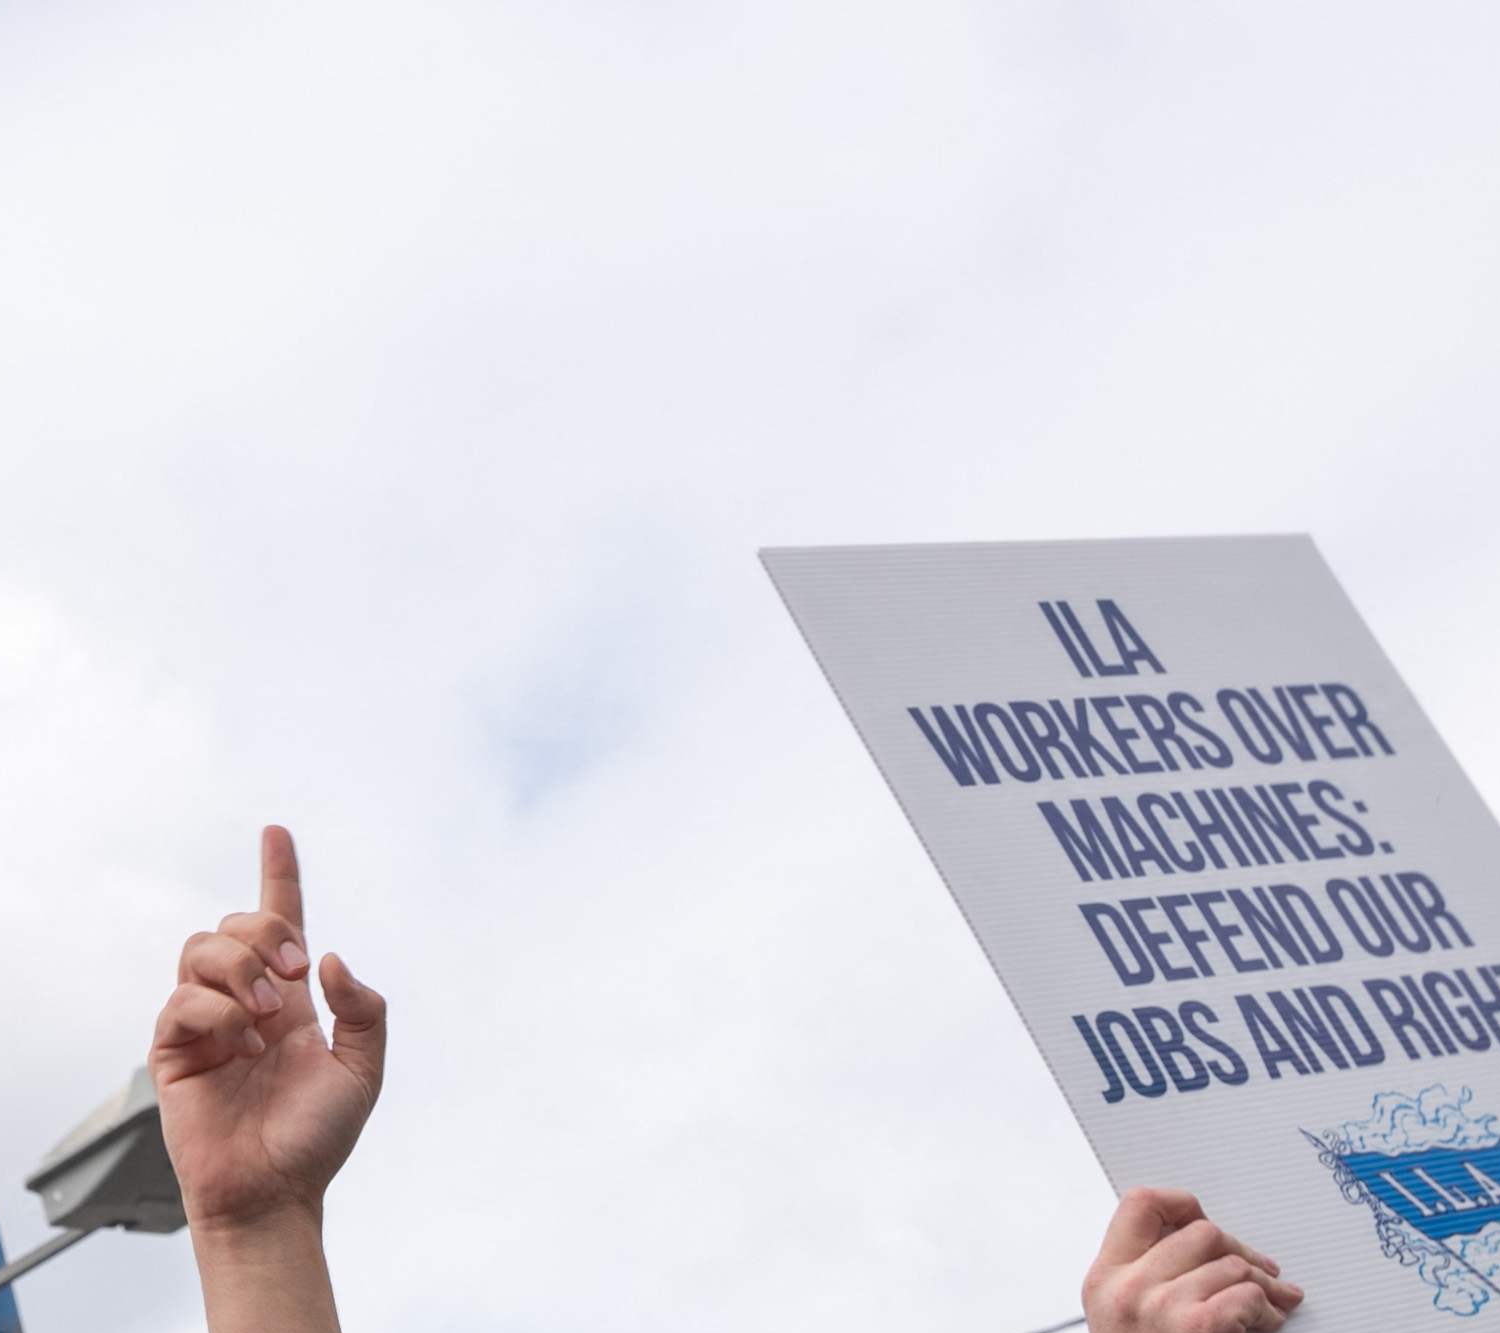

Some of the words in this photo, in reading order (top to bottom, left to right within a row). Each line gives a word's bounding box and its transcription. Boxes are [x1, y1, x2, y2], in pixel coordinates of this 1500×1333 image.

[1038, 599, 1166, 677] ILA
[908, 688, 1234, 787] WORKERS
[1214, 681, 1396, 764] OVER
[1037, 778, 1394, 882] MACHINES:
[1078, 882, 1343, 986] DEFEND
[1328, 871, 1474, 960] OUR
[1072, 1000, 1249, 1104] JOBS
[1234, 985, 1386, 1081] AND
